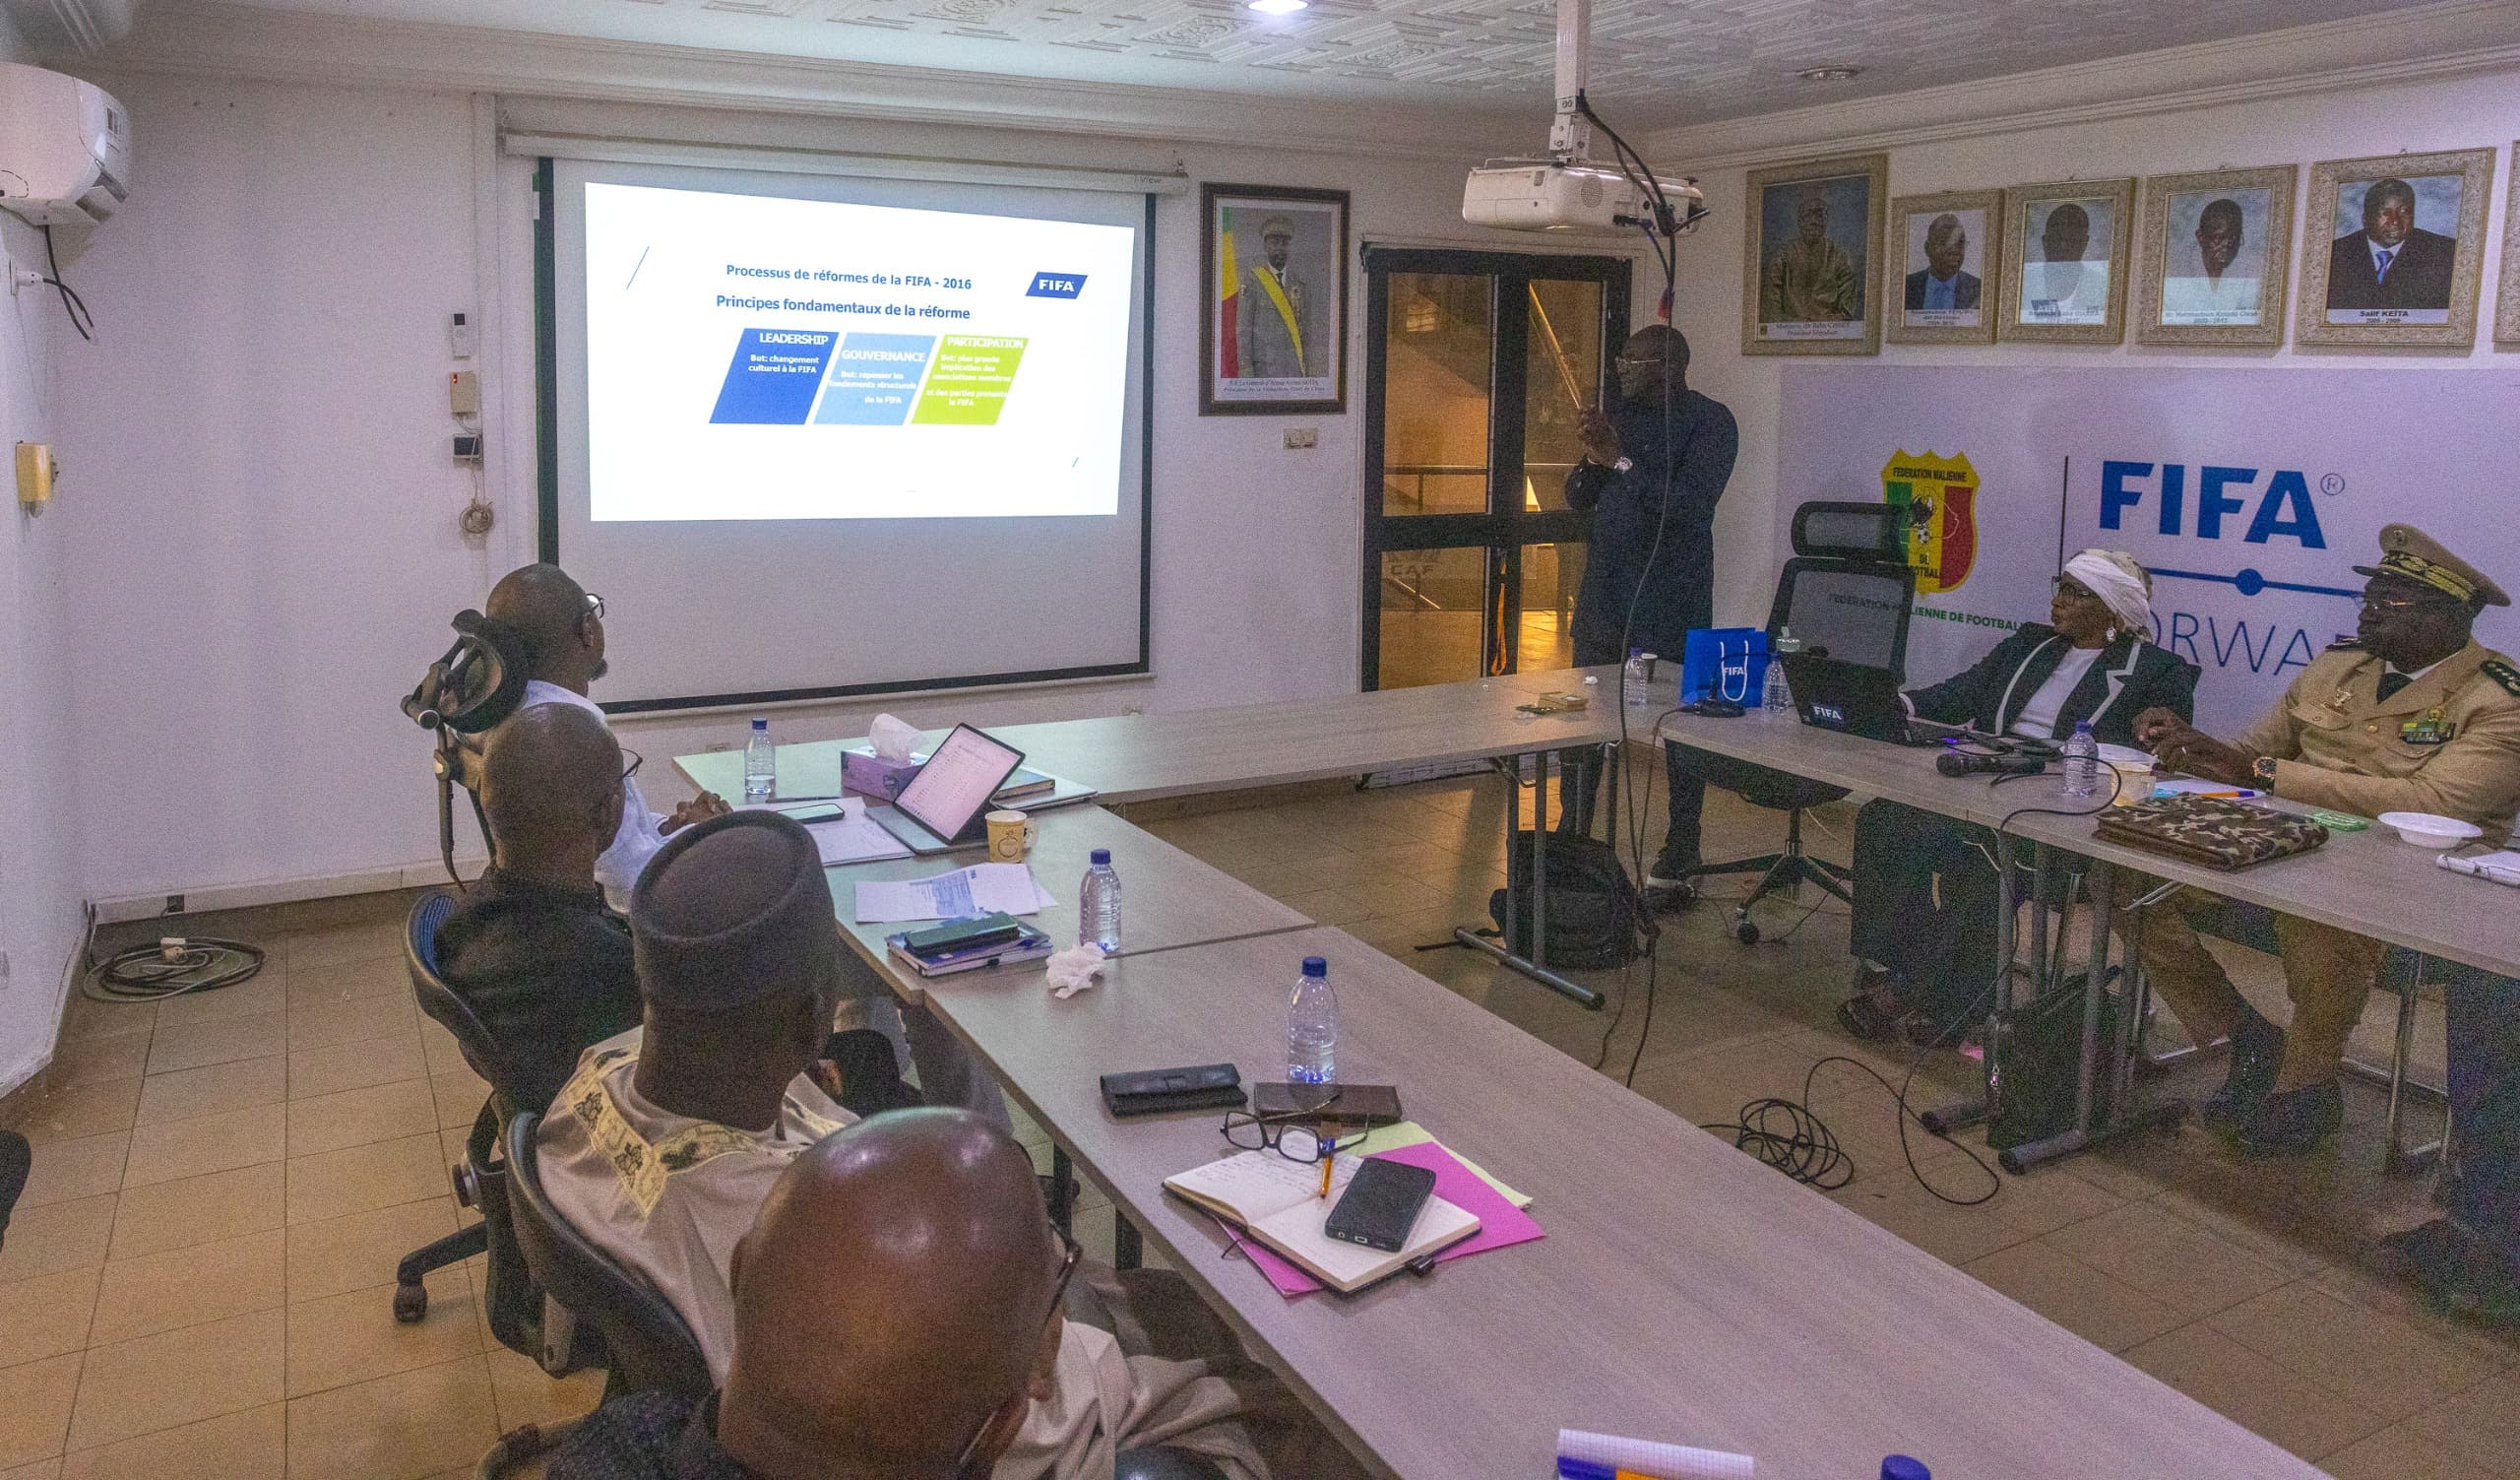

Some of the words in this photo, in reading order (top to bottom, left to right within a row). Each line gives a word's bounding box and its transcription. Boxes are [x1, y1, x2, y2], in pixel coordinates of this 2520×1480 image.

[726, 265, 790, 279] Processus
[794, 269, 810, 280] de
[813, 270, 869, 284] réformes
[872, 274, 887, 285] de
[891, 275, 901, 286] la
[905, 276, 932, 287] FIFA
[942, 278, 972, 290] 2016
[1039, 279, 1075, 292] FIFA
[717, 295, 781, 311] Principes
[784, 298, 882, 314] fondamentaux
[884, 303, 902, 315] de
[904, 304, 915, 316] la
[918, 305, 971, 319] réforme
[759, 333, 829, 346] LEADERSHIP
[947, 337, 1025, 349] PARTICIPATION
[769, 354, 820, 364] changement
[842, 350, 925, 362] GOUVERNANCE
[797, 365, 817, 374] FIFA
[885, 396, 903, 405] FIFA
[2100, 461, 2327, 549] FIFA
[1949, 611, 1964, 622] DE
[1724, 666, 1744, 676] FIFA
[1811, 705, 1843, 721] FIFA
